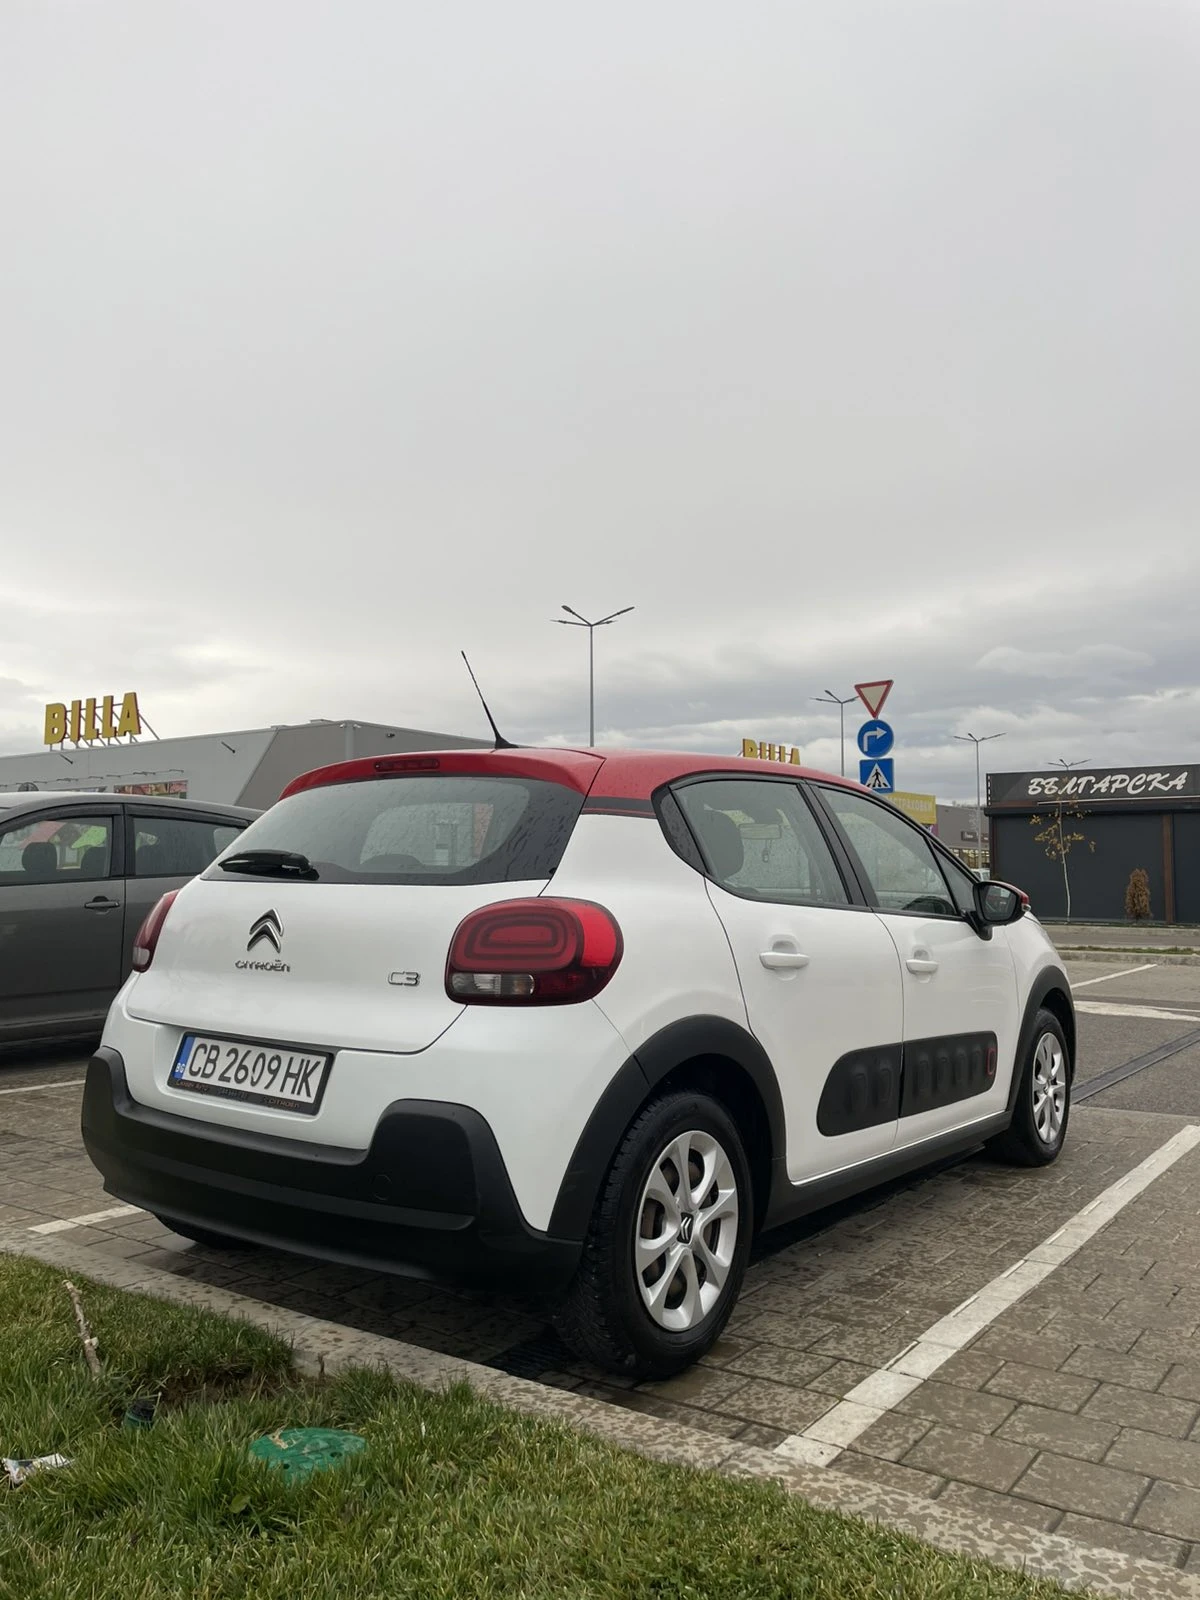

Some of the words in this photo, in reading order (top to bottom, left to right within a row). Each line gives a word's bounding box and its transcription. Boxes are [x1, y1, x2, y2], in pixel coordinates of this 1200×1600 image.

[44, 691, 141, 745] BILLA
[1027, 771, 1189, 796] БЪЛГАРСКА
[387, 970, 421, 987] C3
[175, 1062, 185, 1074] BG
